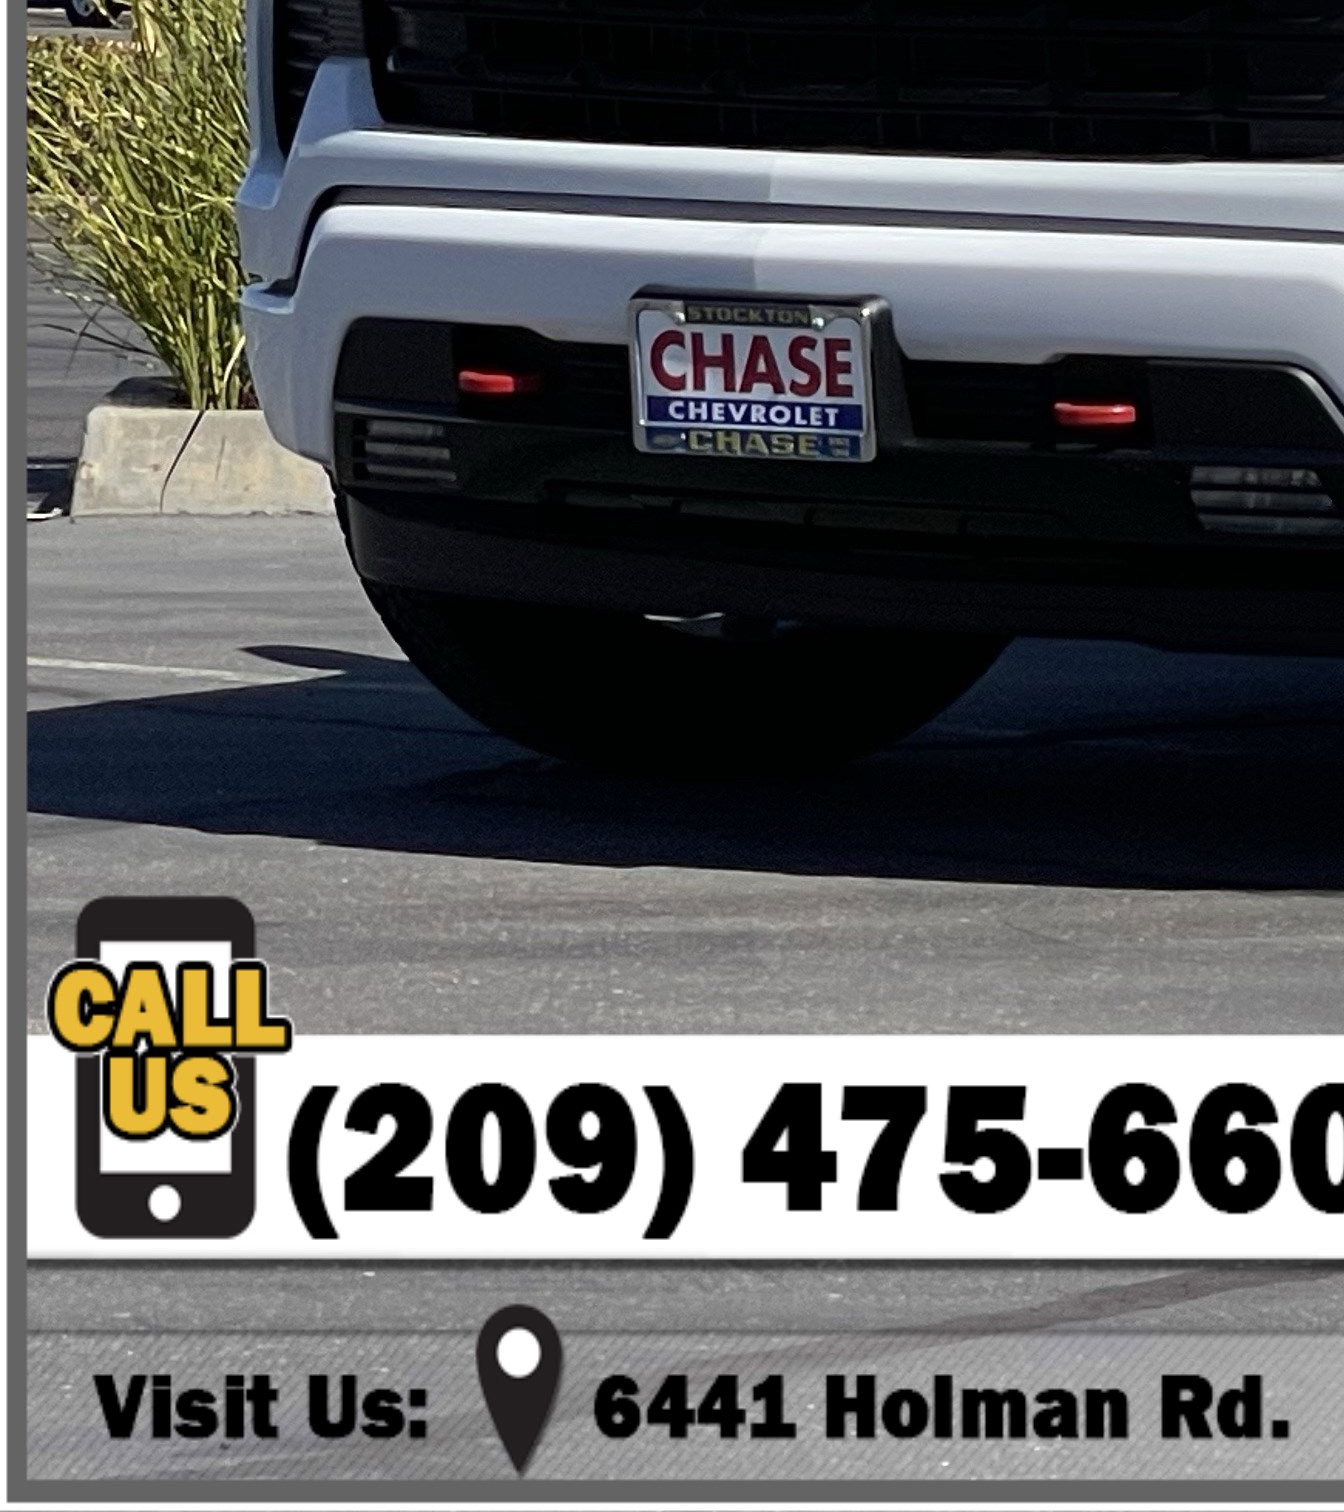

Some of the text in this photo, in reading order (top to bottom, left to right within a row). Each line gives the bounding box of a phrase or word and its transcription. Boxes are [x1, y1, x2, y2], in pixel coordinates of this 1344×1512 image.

[687, 306, 808, 325] STOCKTON
[650, 330, 854, 398] CHASE
[668, 400, 839, 428] CHEVROLET
[688, 429, 817, 459] CHASE
